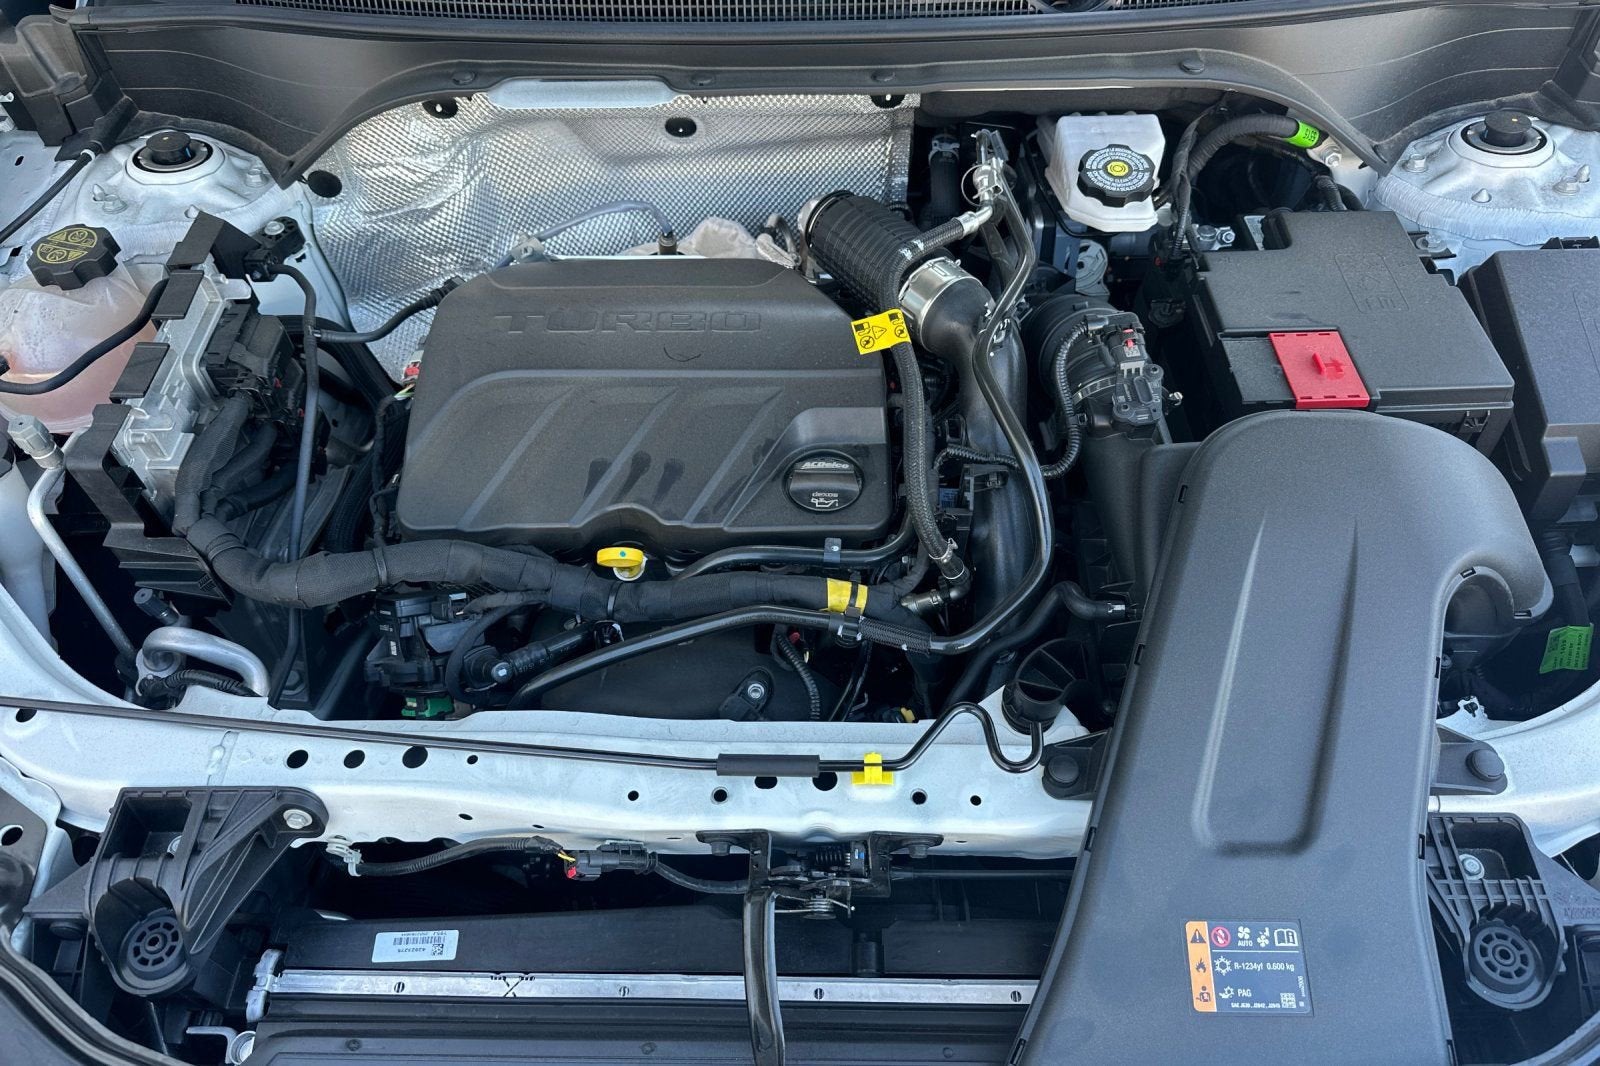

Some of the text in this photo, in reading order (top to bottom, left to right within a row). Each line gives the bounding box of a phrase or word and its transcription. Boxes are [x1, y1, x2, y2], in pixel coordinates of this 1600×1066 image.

[494, 310, 761, 333] TURBO
[1234, 962, 1295, 972] R-1234yf 0.600 kg
[1237, 988, 1252, 997] PAG
